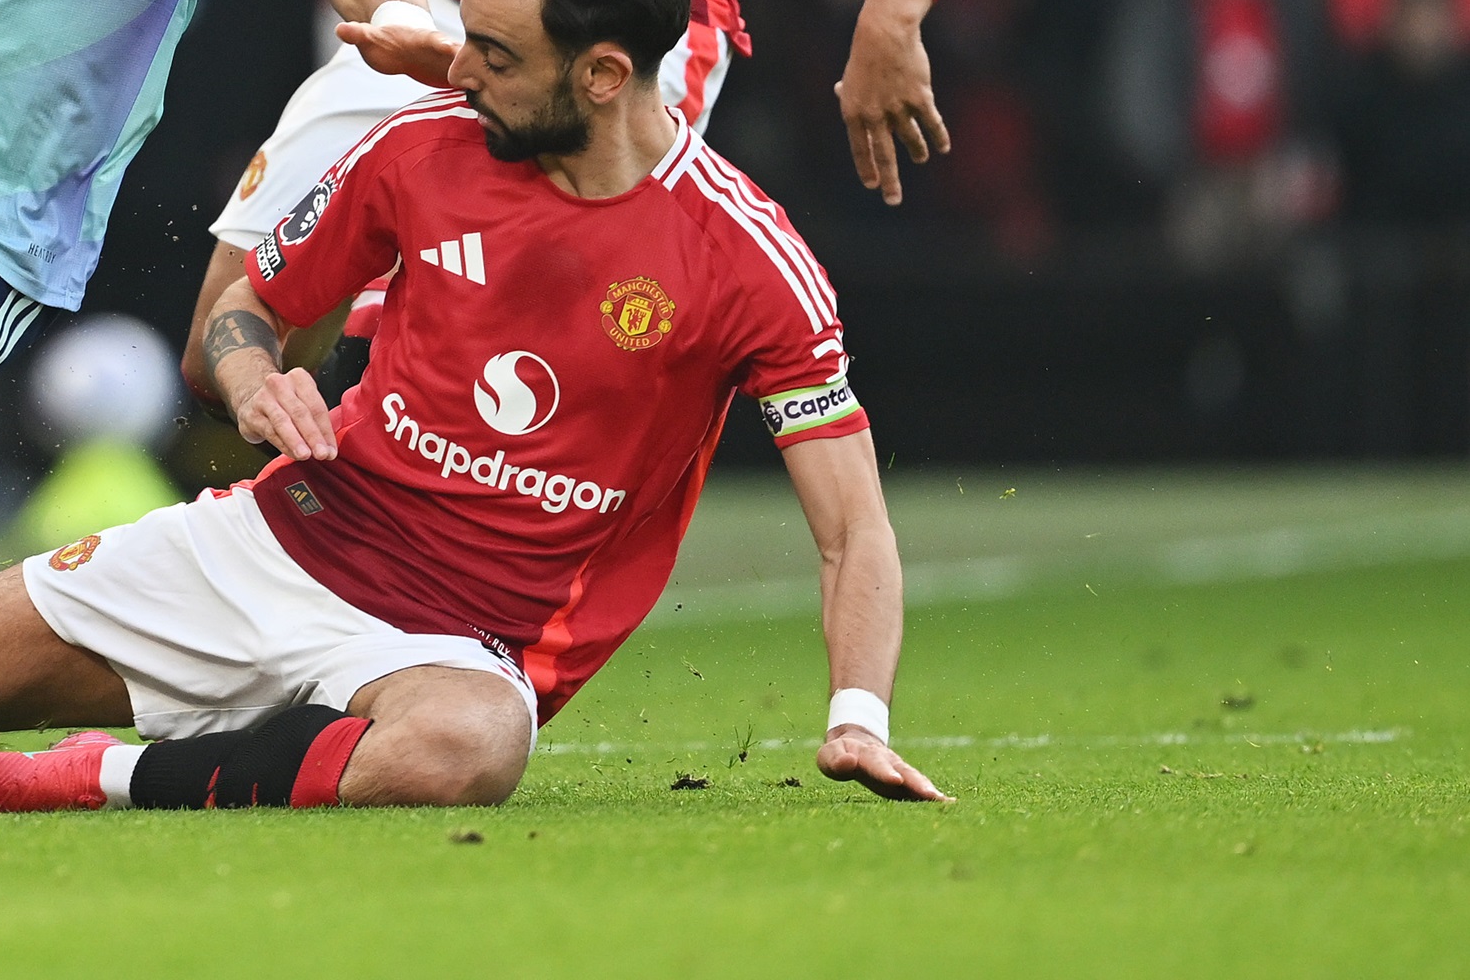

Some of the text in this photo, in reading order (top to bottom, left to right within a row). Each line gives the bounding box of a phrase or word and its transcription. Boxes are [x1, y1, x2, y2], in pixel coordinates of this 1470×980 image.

[612, 281, 669, 315] MANCHESTER
[610, 327, 650, 347] UNITED
[783, 387, 850, 419] Capta
[381, 392, 627, 514] Snapdragon
